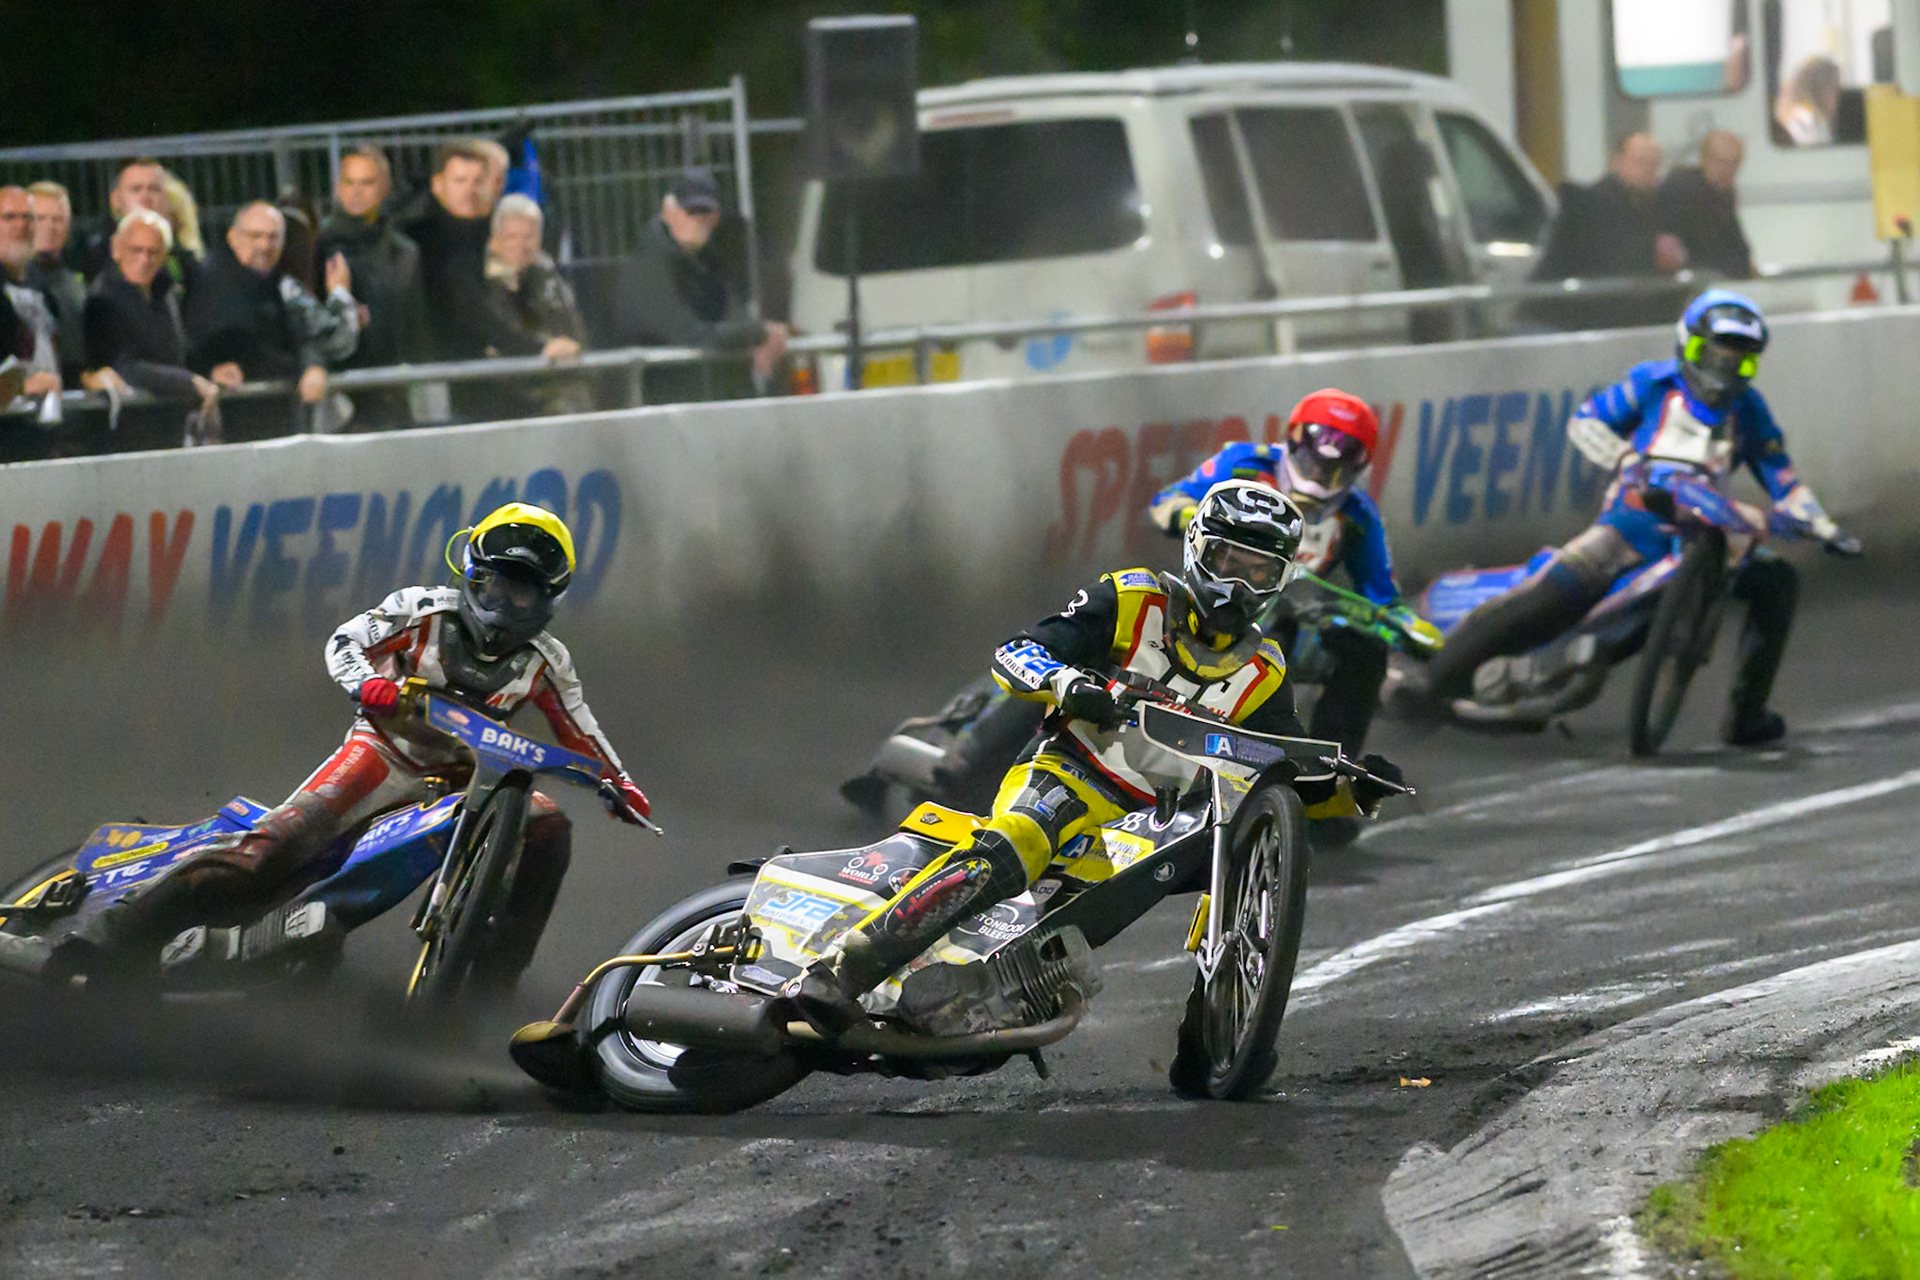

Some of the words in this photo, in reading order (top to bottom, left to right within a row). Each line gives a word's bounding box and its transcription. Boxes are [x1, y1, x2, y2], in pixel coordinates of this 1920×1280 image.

[1043, 401, 1406, 562] SPEEY
[4, 508, 195, 634] WAY
[207, 467, 621, 632] VEENOD
[998, 649, 1043, 688] OTOREN.NL
[481, 727, 546, 764] BAK'S
[841, 866, 879, 882] WORLD
